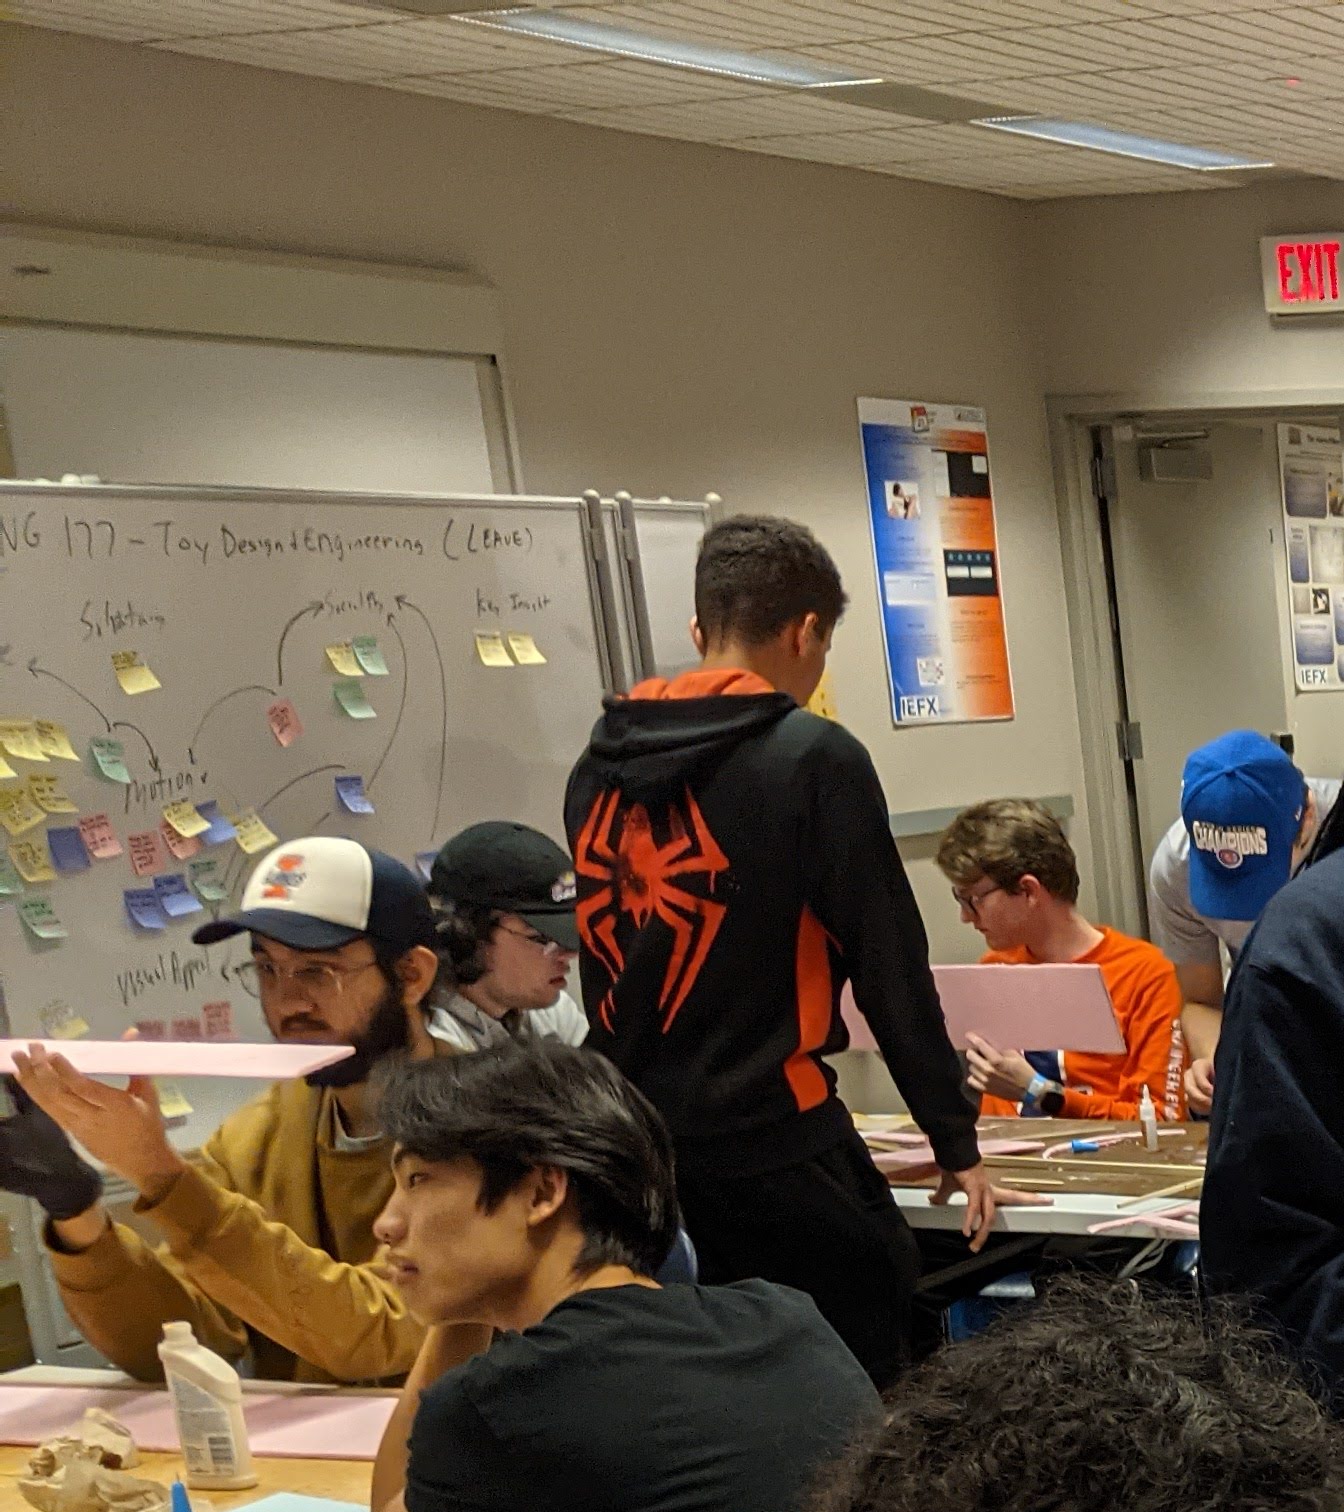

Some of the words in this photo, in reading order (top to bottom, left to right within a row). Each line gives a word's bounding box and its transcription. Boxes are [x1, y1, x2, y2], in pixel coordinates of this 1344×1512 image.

[1278, 243, 1340, 300] EXIT
[64, 515, 115, 559] 177
[154, 519, 209, 567] Toy
[221, 523, 284, 558] Design
[1300, 669, 1327, 685] IEFX
[901, 696, 938, 717] IEFX
